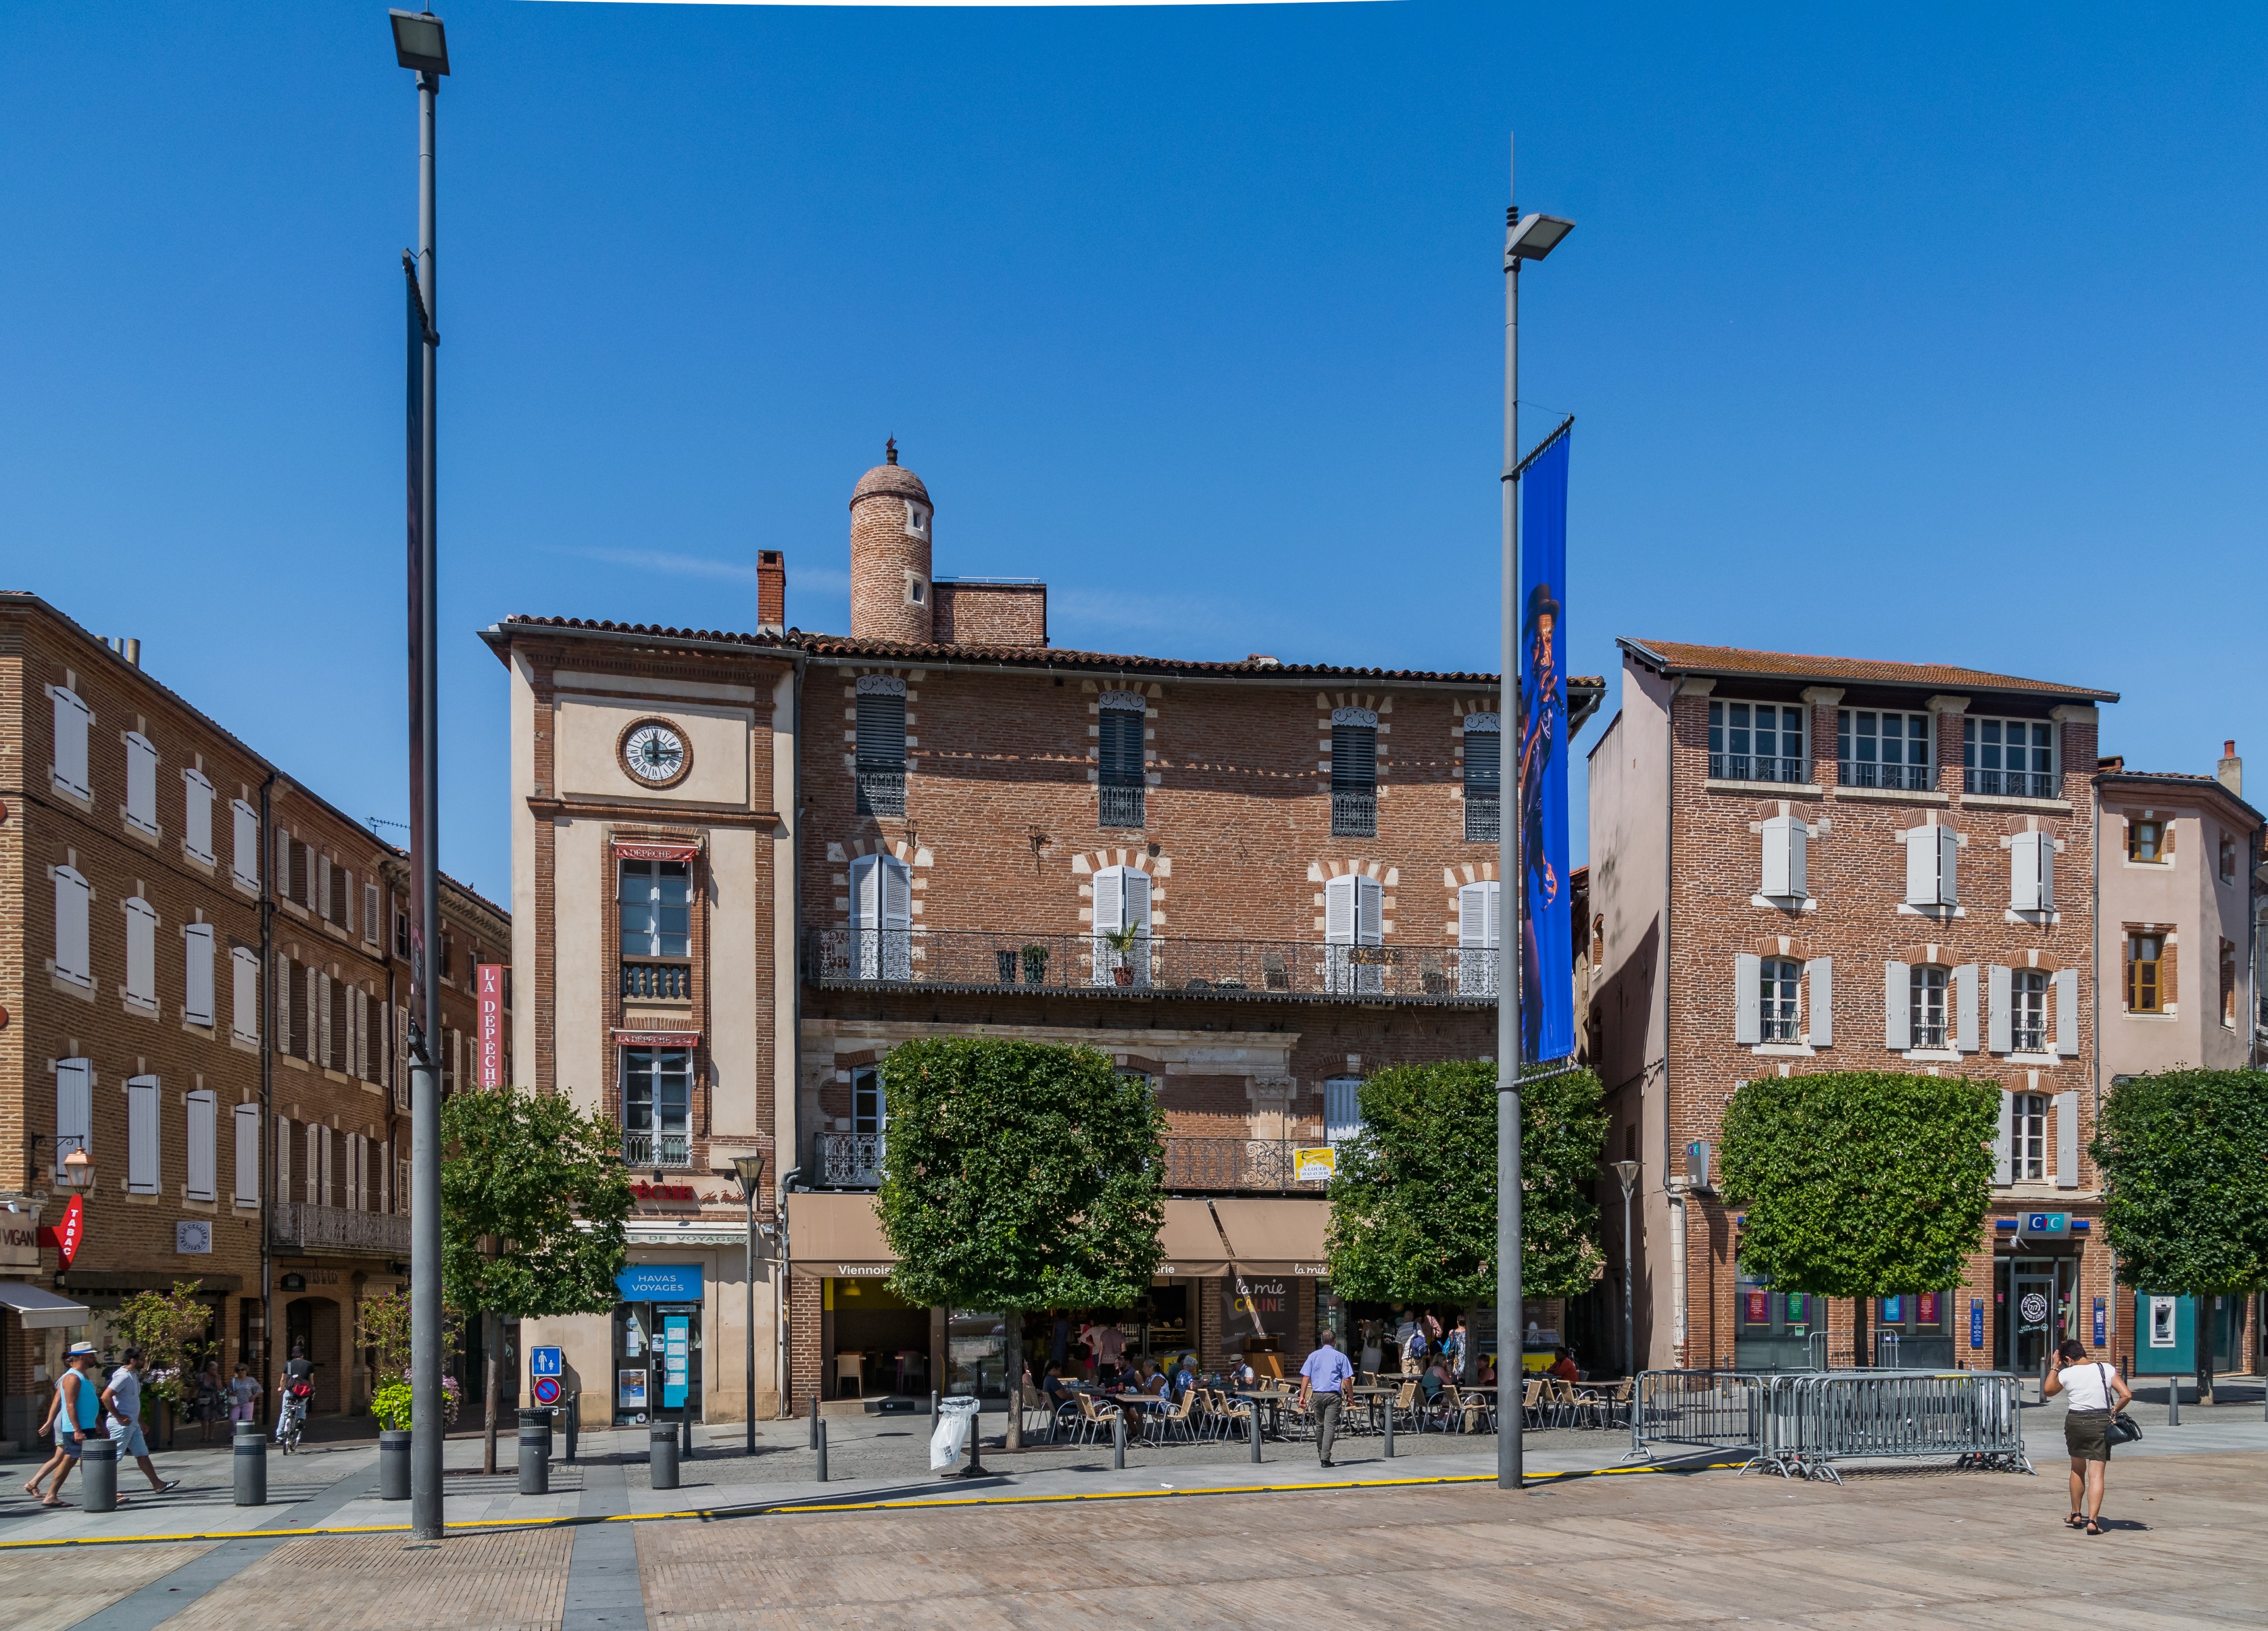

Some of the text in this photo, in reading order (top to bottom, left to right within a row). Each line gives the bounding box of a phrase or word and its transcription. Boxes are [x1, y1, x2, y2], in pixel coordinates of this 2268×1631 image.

[484, 969, 496, 992] LA
[2032, 1217, 2060, 1228] CIC
[2, 1228, 34, 1246] VIGAN
[63, 1209, 78, 1255] TABAC
[188, 1224, 208, 1239] CELLIER
[1294, 1263, 1327, 1274] la mie
[1235, 1278, 1286, 1294] la mie
[1234, 1295, 1285, 1312] CÂLINE
[2032, 1296, 2045, 1307] SERVICE
